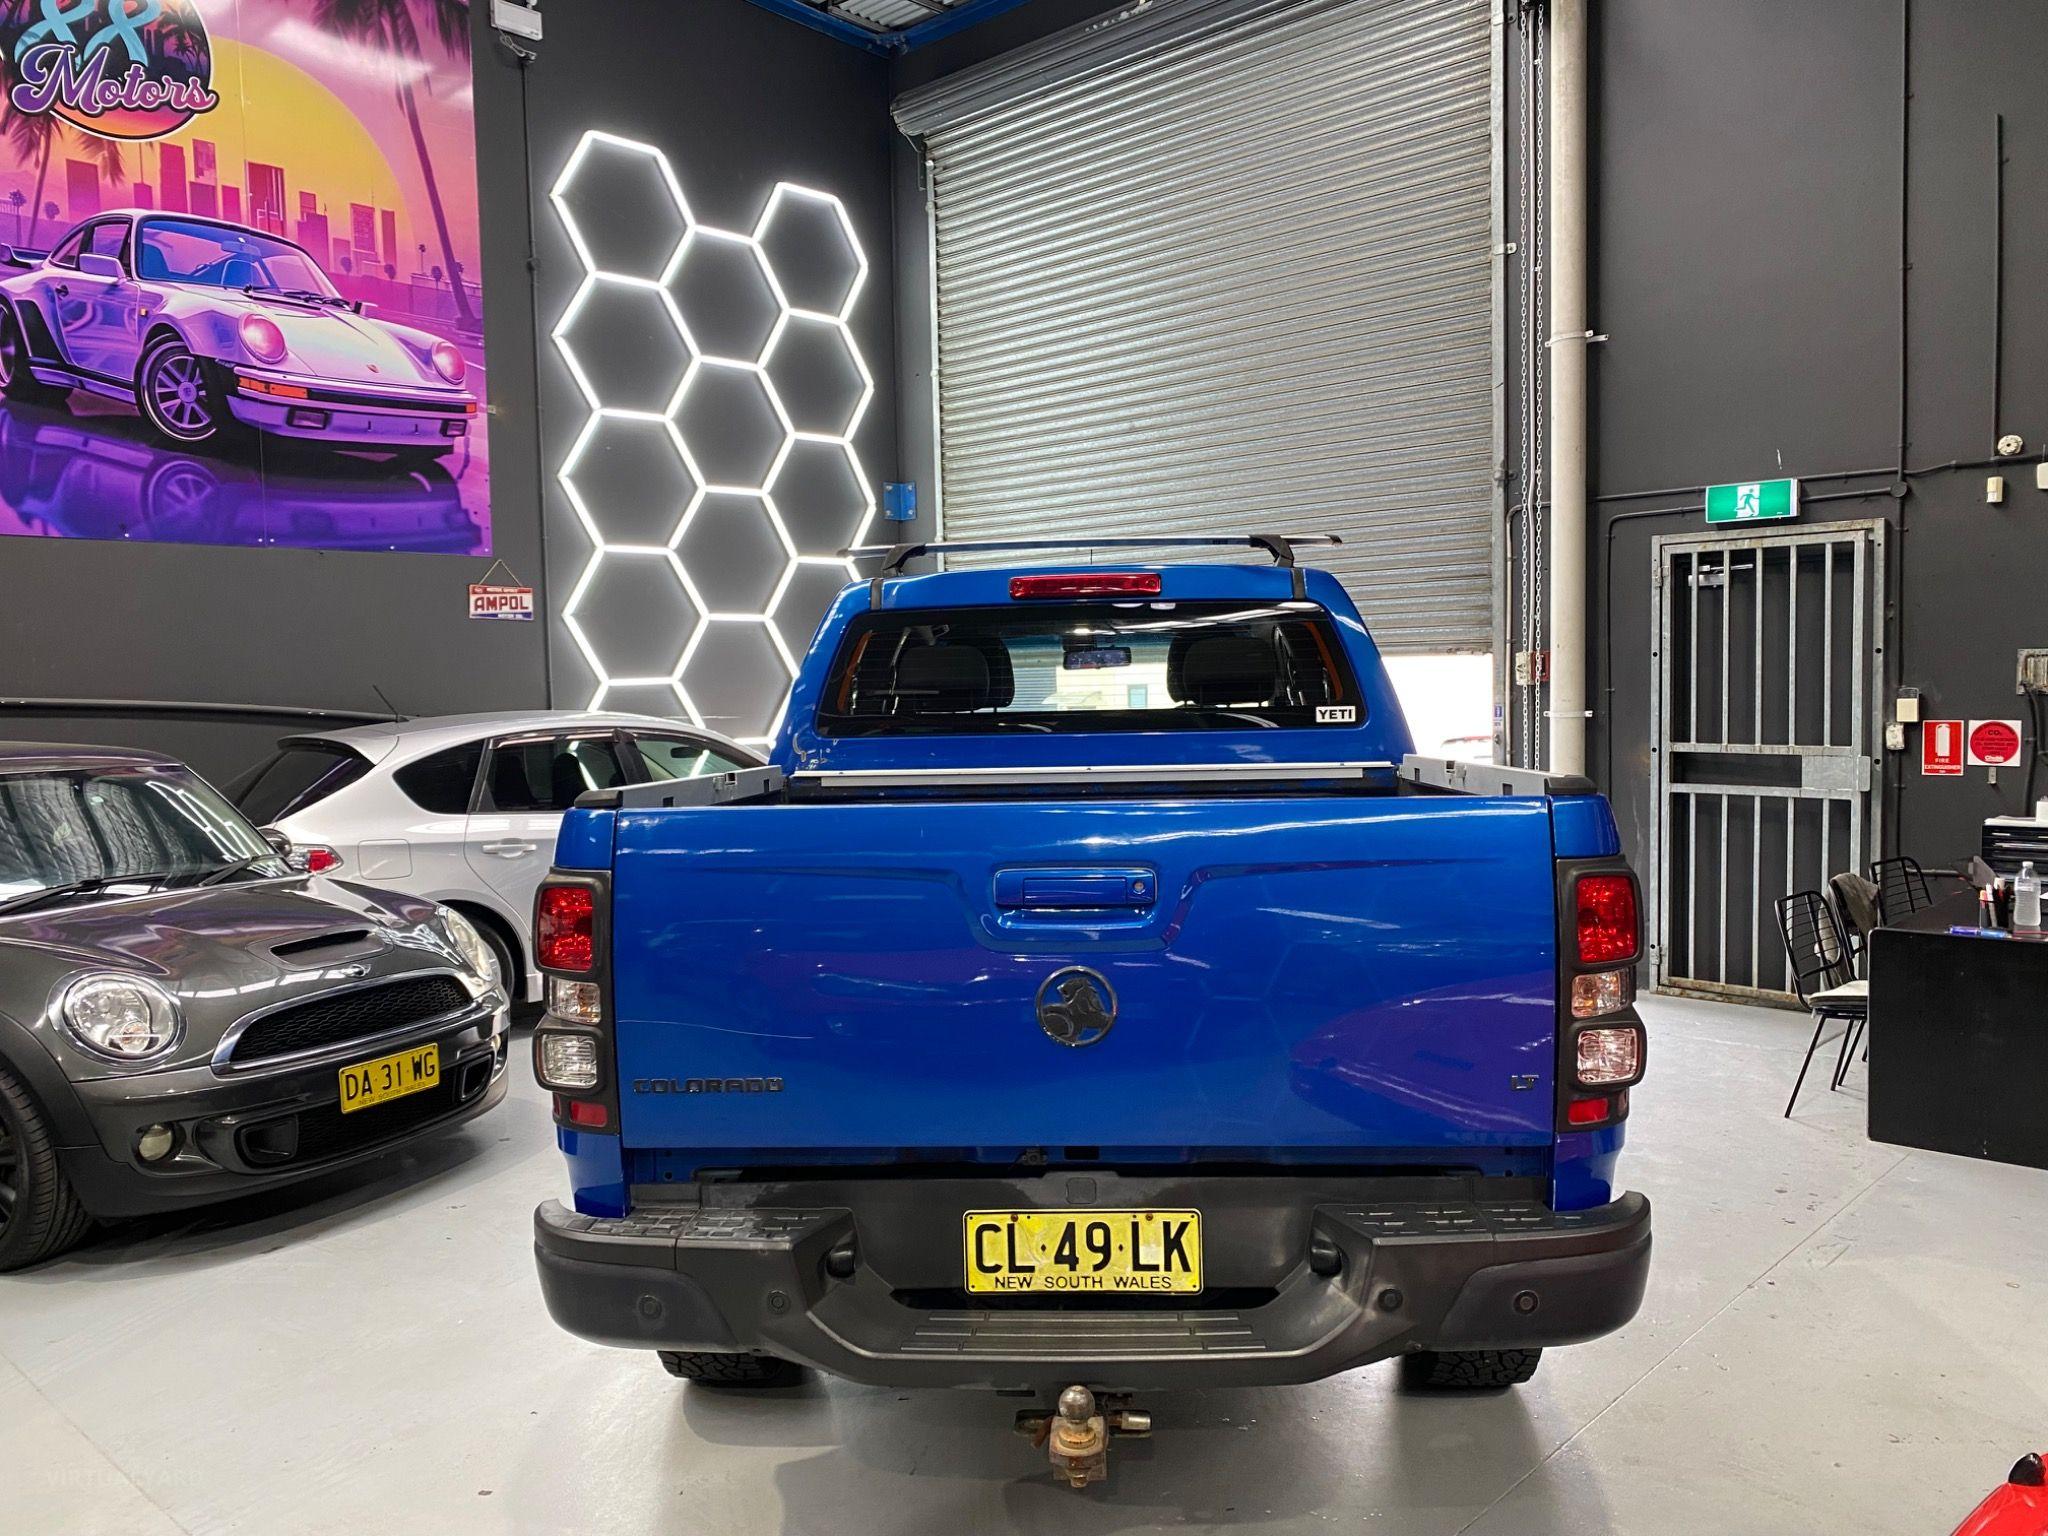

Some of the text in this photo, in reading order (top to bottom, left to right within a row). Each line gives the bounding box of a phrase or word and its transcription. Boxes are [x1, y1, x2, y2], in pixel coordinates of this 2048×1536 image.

[12, 44, 218, 114] Motors
[474, 596, 529, 611] AMPOL
[1318, 708, 1353, 720] YETI
[345, 1051, 436, 1101] DA 31 WG
[1511, 1074, 1540, 1091] LT
[633, 1077, 785, 1093] COLORADO
[975, 1220, 1192, 1274] CL 49 LK
[994, 1275, 1172, 1289] NEW SOUTH WALES
